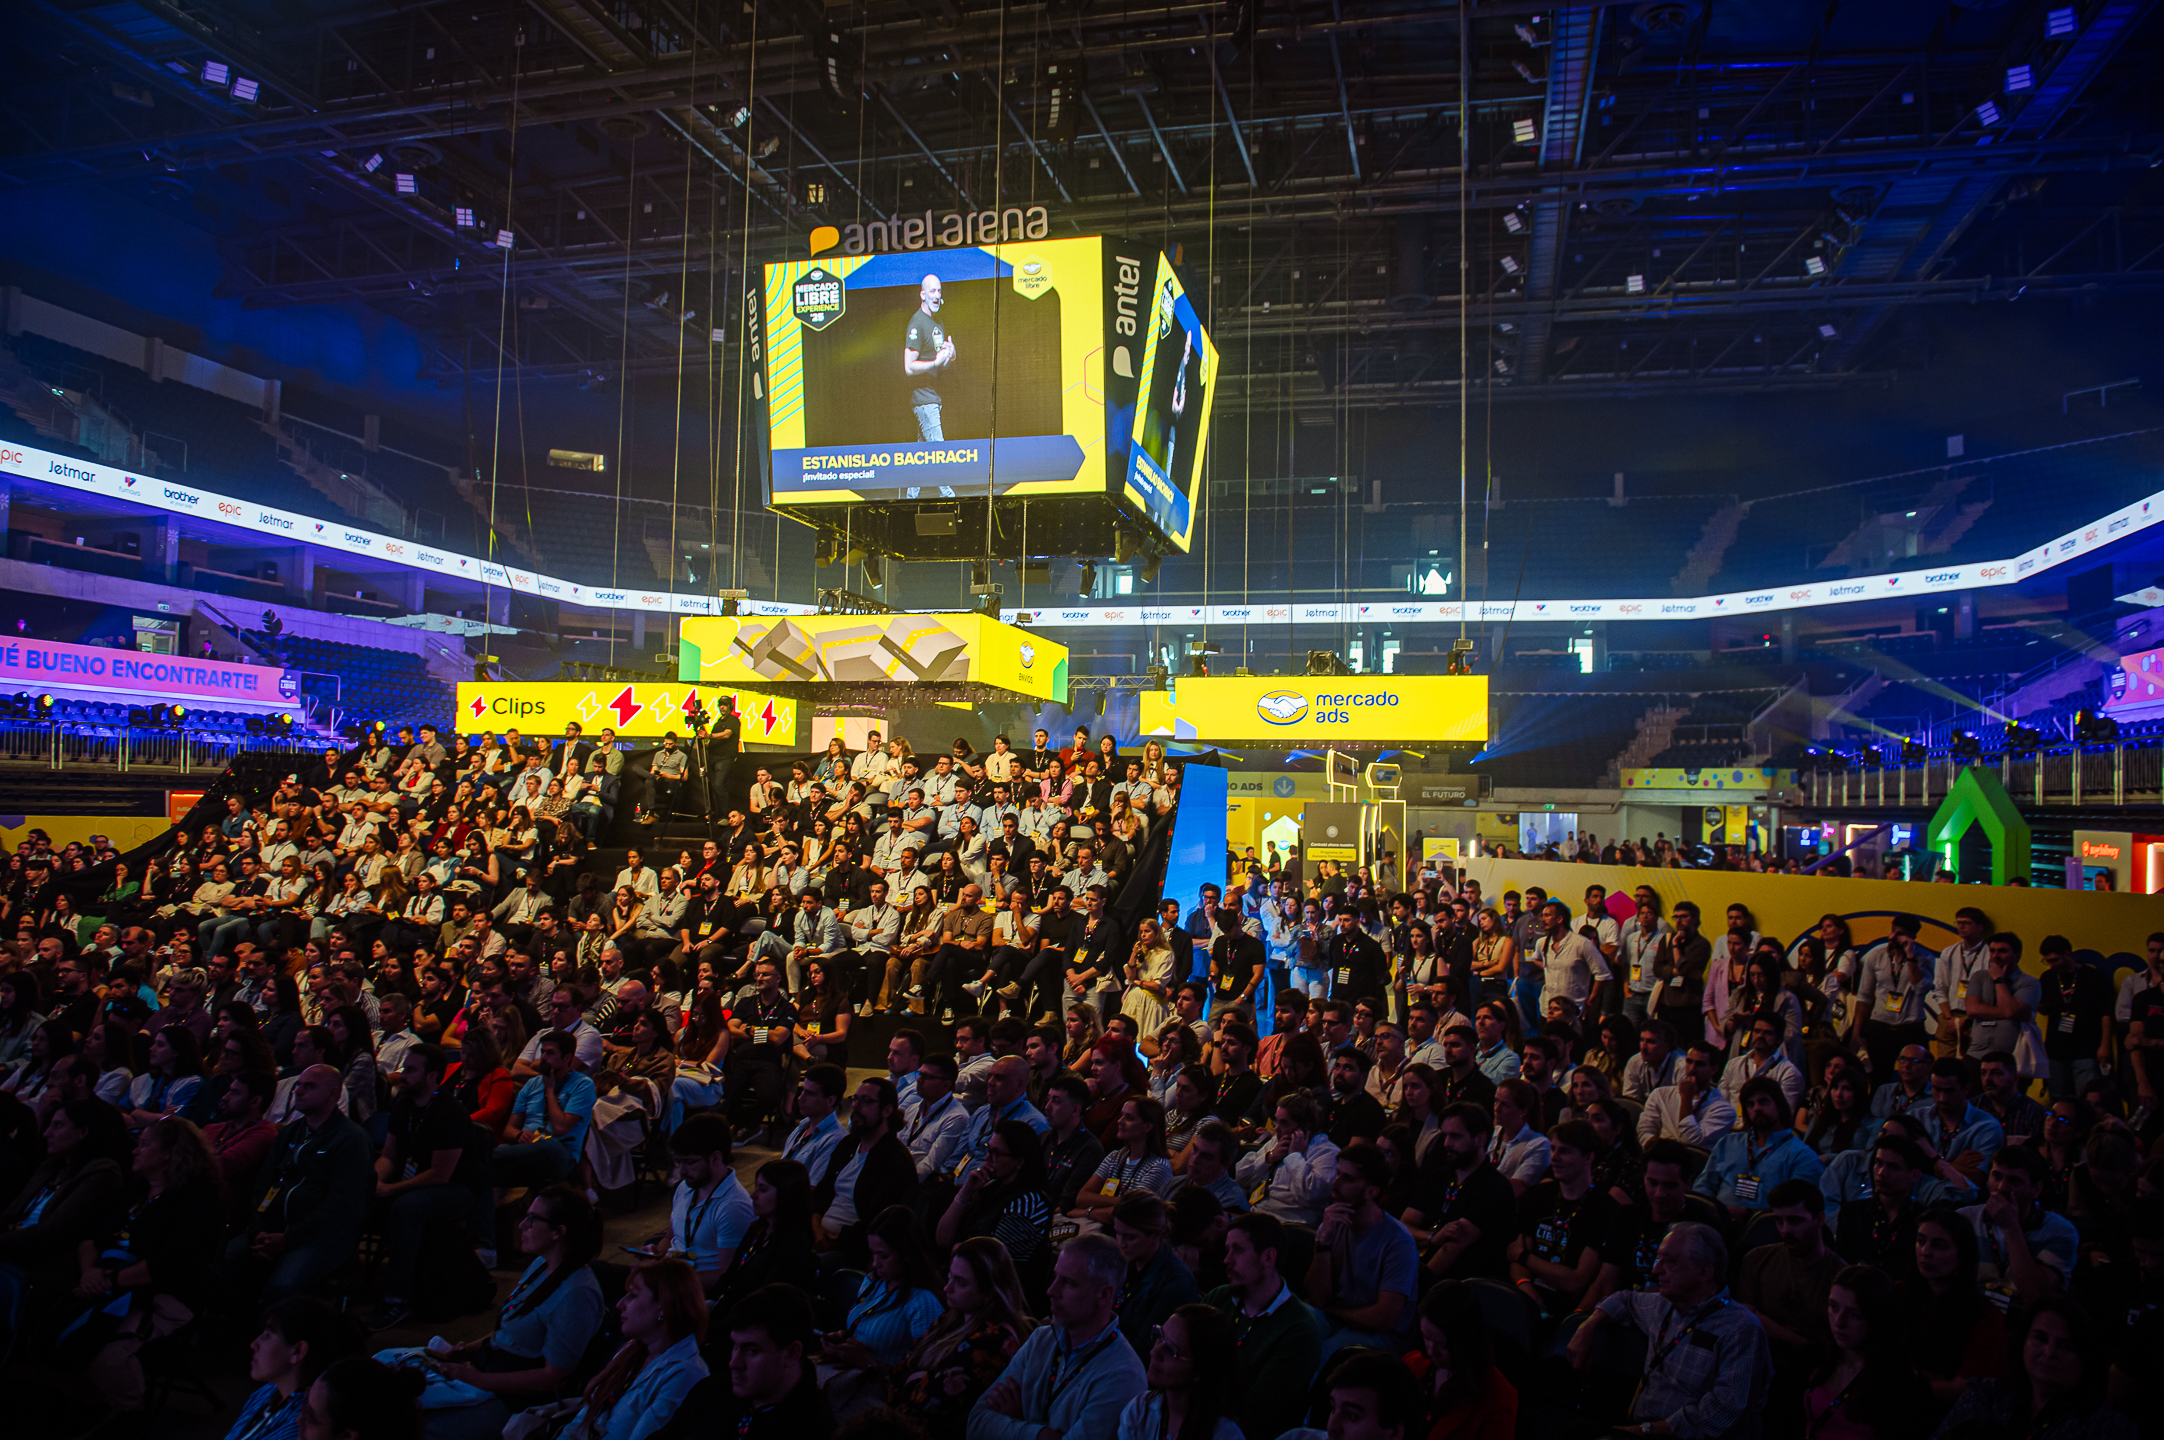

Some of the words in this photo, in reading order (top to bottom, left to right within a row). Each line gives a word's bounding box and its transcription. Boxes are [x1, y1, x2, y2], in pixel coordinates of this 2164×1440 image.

[844, 209, 933, 254] antel
[942, 206, 1048, 246] arena
[1018, 275, 1048, 284] mercado
[795, 282, 839, 293] MERCADO
[795, 290, 840, 306] LIBRE
[1116, 256, 1141, 337] antel
[796, 303, 840, 314] EXPERIENCE
[747, 288, 760, 362] antel
[0, 449, 23, 464] pic
[802, 453, 891, 470] ESTANISLAO
[894, 449, 978, 466] BACHRACH
[839, 470, 875, 481] especial!
[164, 487, 200, 505] brother
[218, 502, 242, 517] epic
[344, 532, 372, 546] brother
[385, 543, 404, 556] epic
[1925, 572, 1961, 584] brother
[1980, 566, 2007, 581] epic
[515, 574, 530, 586] epic
[595, 592, 625, 601] brother
[641, 595, 663, 605] epic
[1790, 589, 1812, 602] epic
[761, 605, 789, 614] brother
[1222, 609, 1251, 617] brother
[1266, 609, 1288, 619] epic
[1392, 606, 1423, 615] brother
[1439, 606, 1461, 618] epic
[1570, 604, 1602, 613] brother
[1619, 603, 1642, 614] epic
[1062, 611, 1090, 619] brother
[1104, 611, 1124, 622] epic
[0, 643, 19, 667] É
[25, 649, 106, 676] BUENO
[112, 659, 259, 691] ENCONTRARTE!
[1316, 690, 1399, 707] mercado
[492, 697, 546, 719] Clips
[1315, 708, 1350, 724] ads
[1240, 782, 1263, 791] ADS
